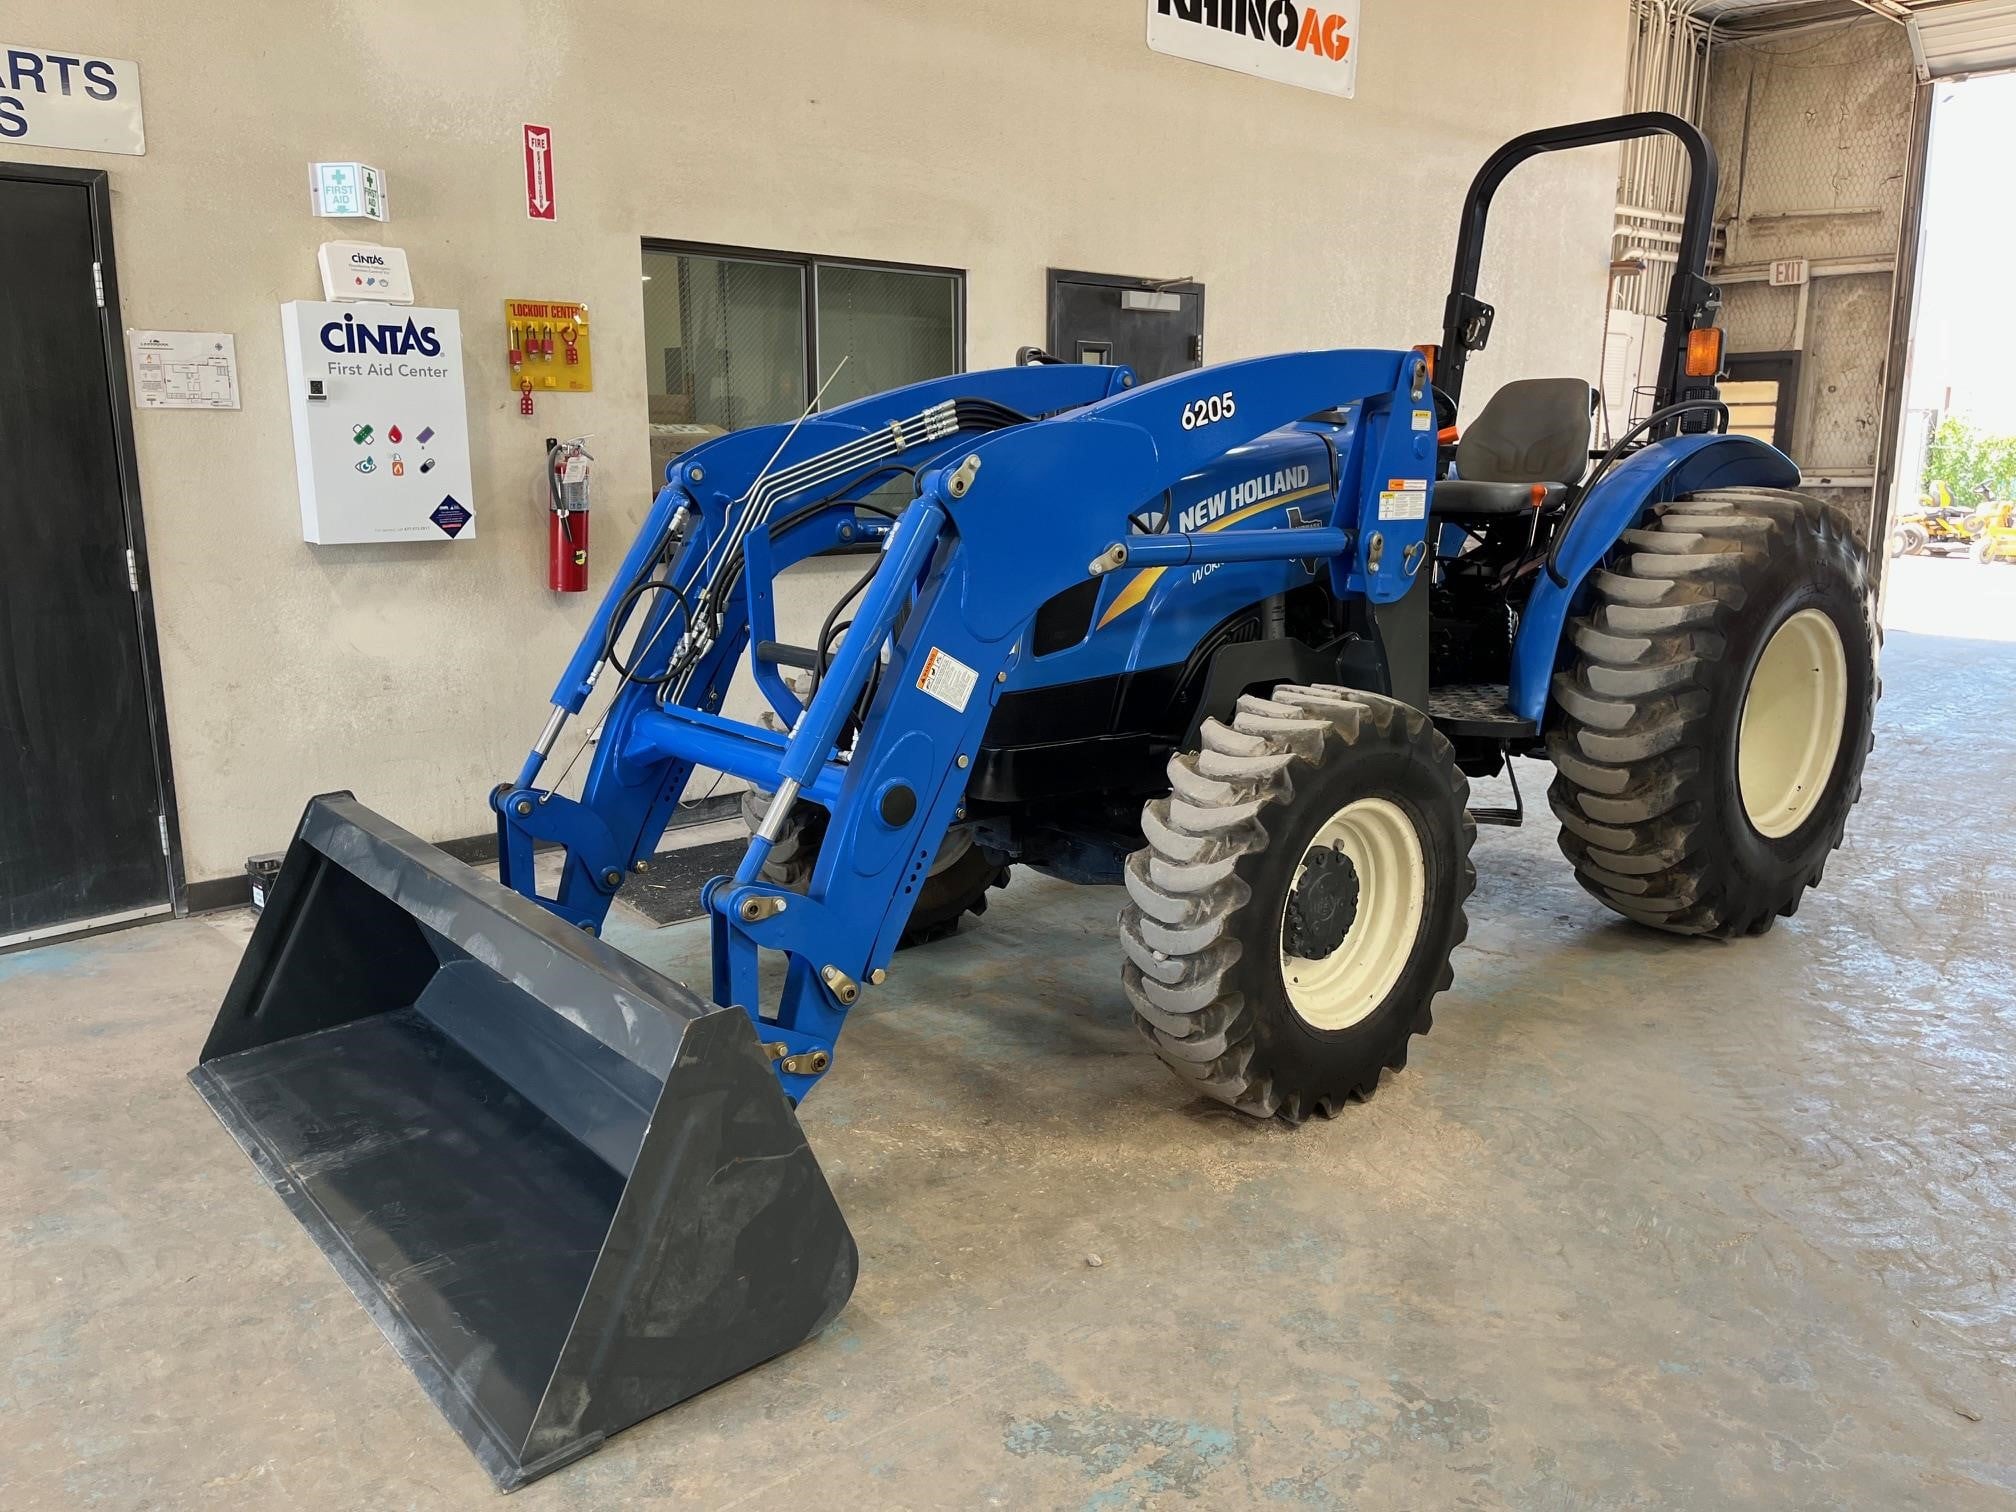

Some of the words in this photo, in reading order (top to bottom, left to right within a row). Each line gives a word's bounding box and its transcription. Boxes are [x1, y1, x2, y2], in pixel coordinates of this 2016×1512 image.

[0, 50, 118, 101] RTS
[531, 138, 545, 148] FIRE
[325, 185, 353, 195] FIRST
[333, 195, 350, 204] AID
[1775, 261, 1803, 283] EXIT
[513, 303, 548, 318] LOCKOUT
[328, 361, 362, 376] First
[367, 363, 392, 376] Aid
[399, 364, 448, 378] Center
[1181, 391, 1236, 430] 6205
[1179, 490, 1226, 534] NEW
[1231, 465, 1309, 511] HOLLAND
